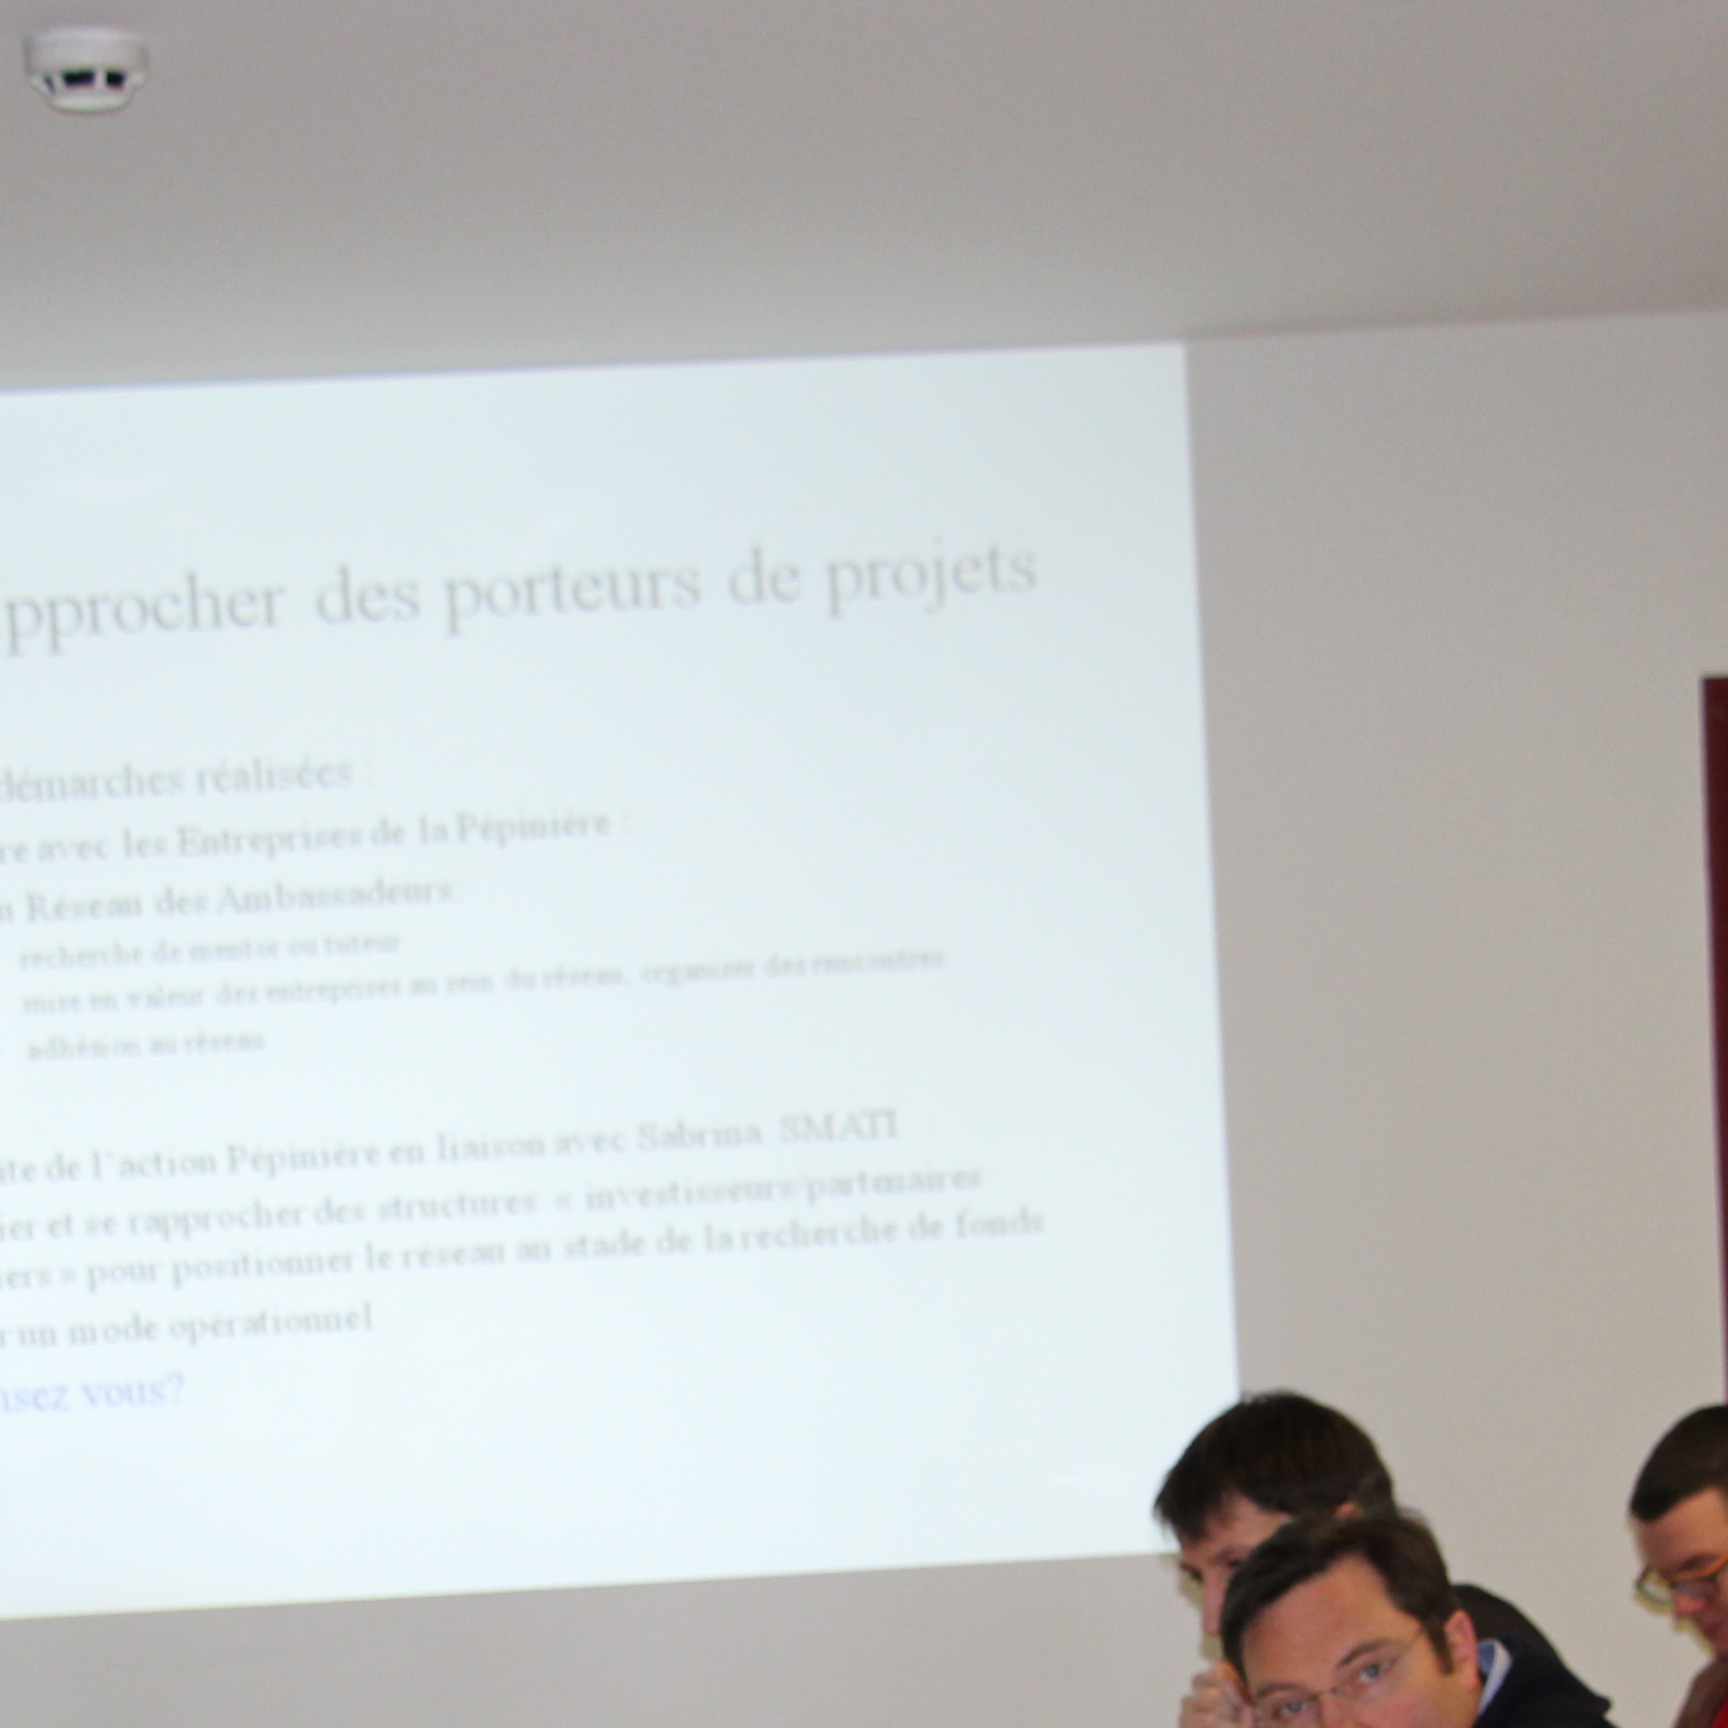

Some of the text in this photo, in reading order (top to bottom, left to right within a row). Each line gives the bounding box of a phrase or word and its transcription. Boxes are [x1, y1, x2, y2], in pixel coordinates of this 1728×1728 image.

[314, 562, 420, 626] des
[442, 560, 702, 637] porteurs
[728, 543, 801, 603] de
[825, 538, 1039, 619] projets
[196, 752, 354, 797] réalisées
[36, 834, 110, 865] avec
[122, 827, 168, 861] les
[176, 818, 364, 860] Entreprises
[370, 816, 407, 847] de
[418, 813, 450, 845] la
[455, 808, 612, 850] Pépinière
[24, 892, 143, 923] Réseau
[153, 885, 208, 917] des
[216, 875, 454, 915] Ambassadeurs
[45, 1151, 82, 1184] de
[224, 1139, 381, 1178] Pépinière
[389, 1139, 426, 1167] en
[435, 1131, 546, 1165] liaison
[553, 1128, 625, 1158] avec
[636, 1119, 763, 1154] Sabrina
[779, 1108, 899, 1145] SMATI
[47, 1209, 76, 1240] et
[126, 1199, 304, 1240] rapprocher
[312, 1193, 369, 1227] des
[376, 1186, 539, 1224] structures
[85, 1260, 161, 1295] pour
[169, 1246, 357, 1290] positionner
[364, 1240, 394, 1272] le
[400, 1234, 506, 1272] réseau
[514, 1232, 553, 1264] au
[562, 1223, 647, 1262] stade
[654, 1222, 693, 1257] de
[703, 1217, 735, 1253] la
[738, 1211, 898, 1254] recherche
[905, 1210, 945, 1244] de
[953, 1204, 1045, 1242] fonds
[18, 1321, 58, 1351] un
[67, 1309, 161, 1349] mode
[168, 1299, 374, 1346] opérationnel
[80, 1369, 187, 1410] vous?
